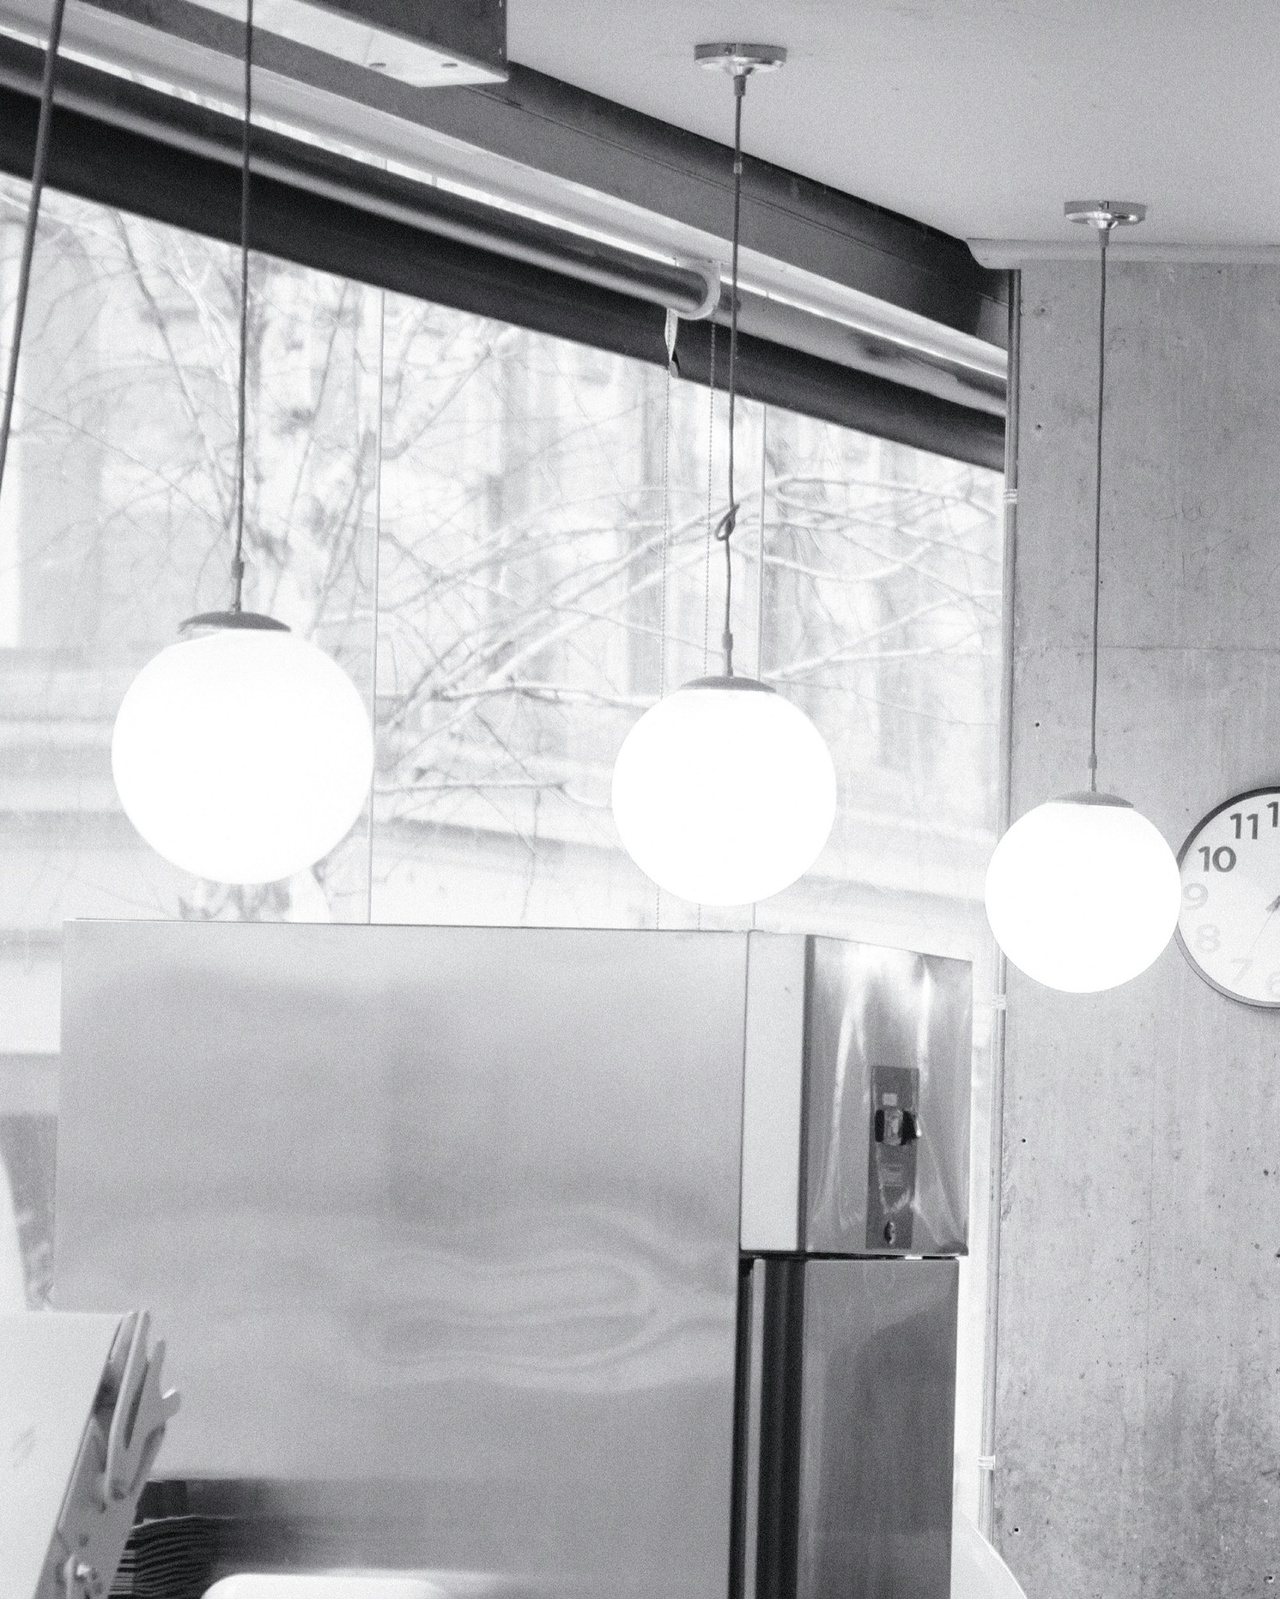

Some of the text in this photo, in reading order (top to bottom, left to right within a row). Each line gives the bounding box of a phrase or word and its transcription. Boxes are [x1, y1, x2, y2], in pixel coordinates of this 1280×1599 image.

[1230, 813, 1259, 839] 11
[1198, 846, 1237, 873] 10
[1183, 883, 1209, 910] 9
[1194, 924, 1221, 953] 8
[1231, 958, 1253, 986] 7
